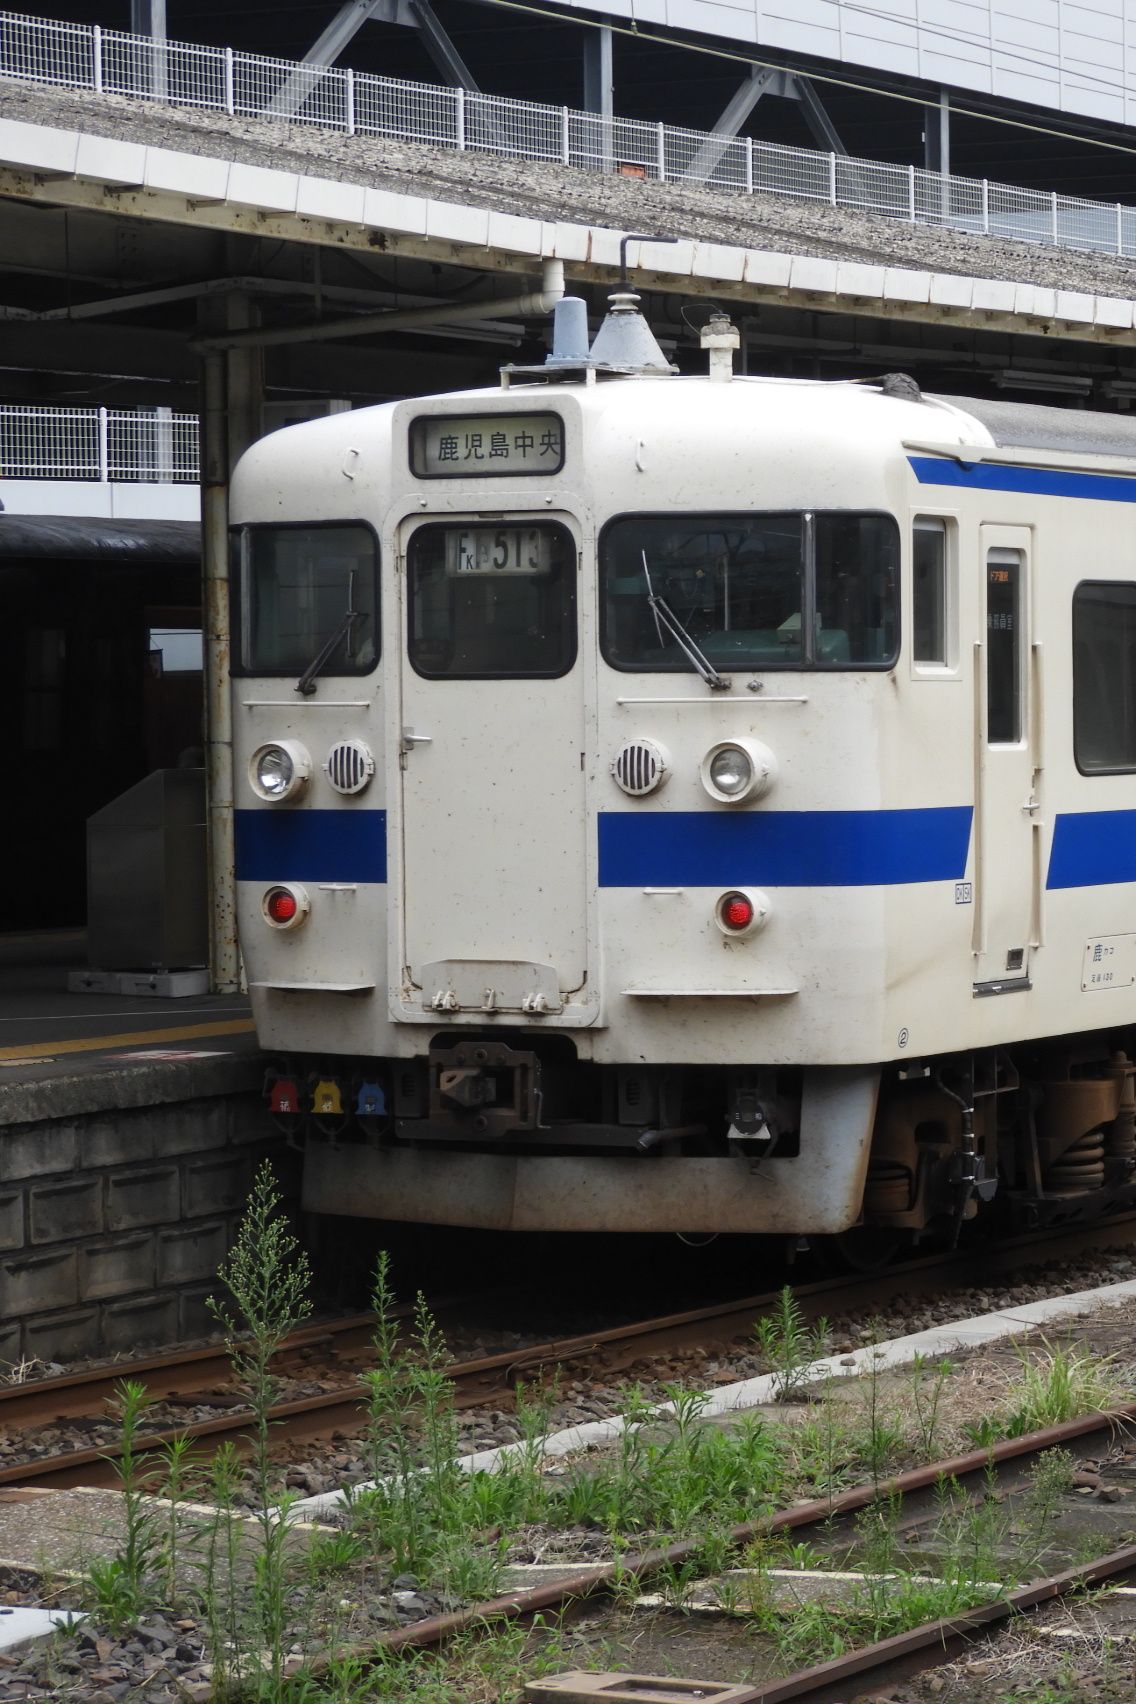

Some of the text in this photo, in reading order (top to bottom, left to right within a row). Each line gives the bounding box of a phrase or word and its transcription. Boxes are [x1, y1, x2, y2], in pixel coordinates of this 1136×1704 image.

[438, 429, 560, 462] 鹿児島中央
